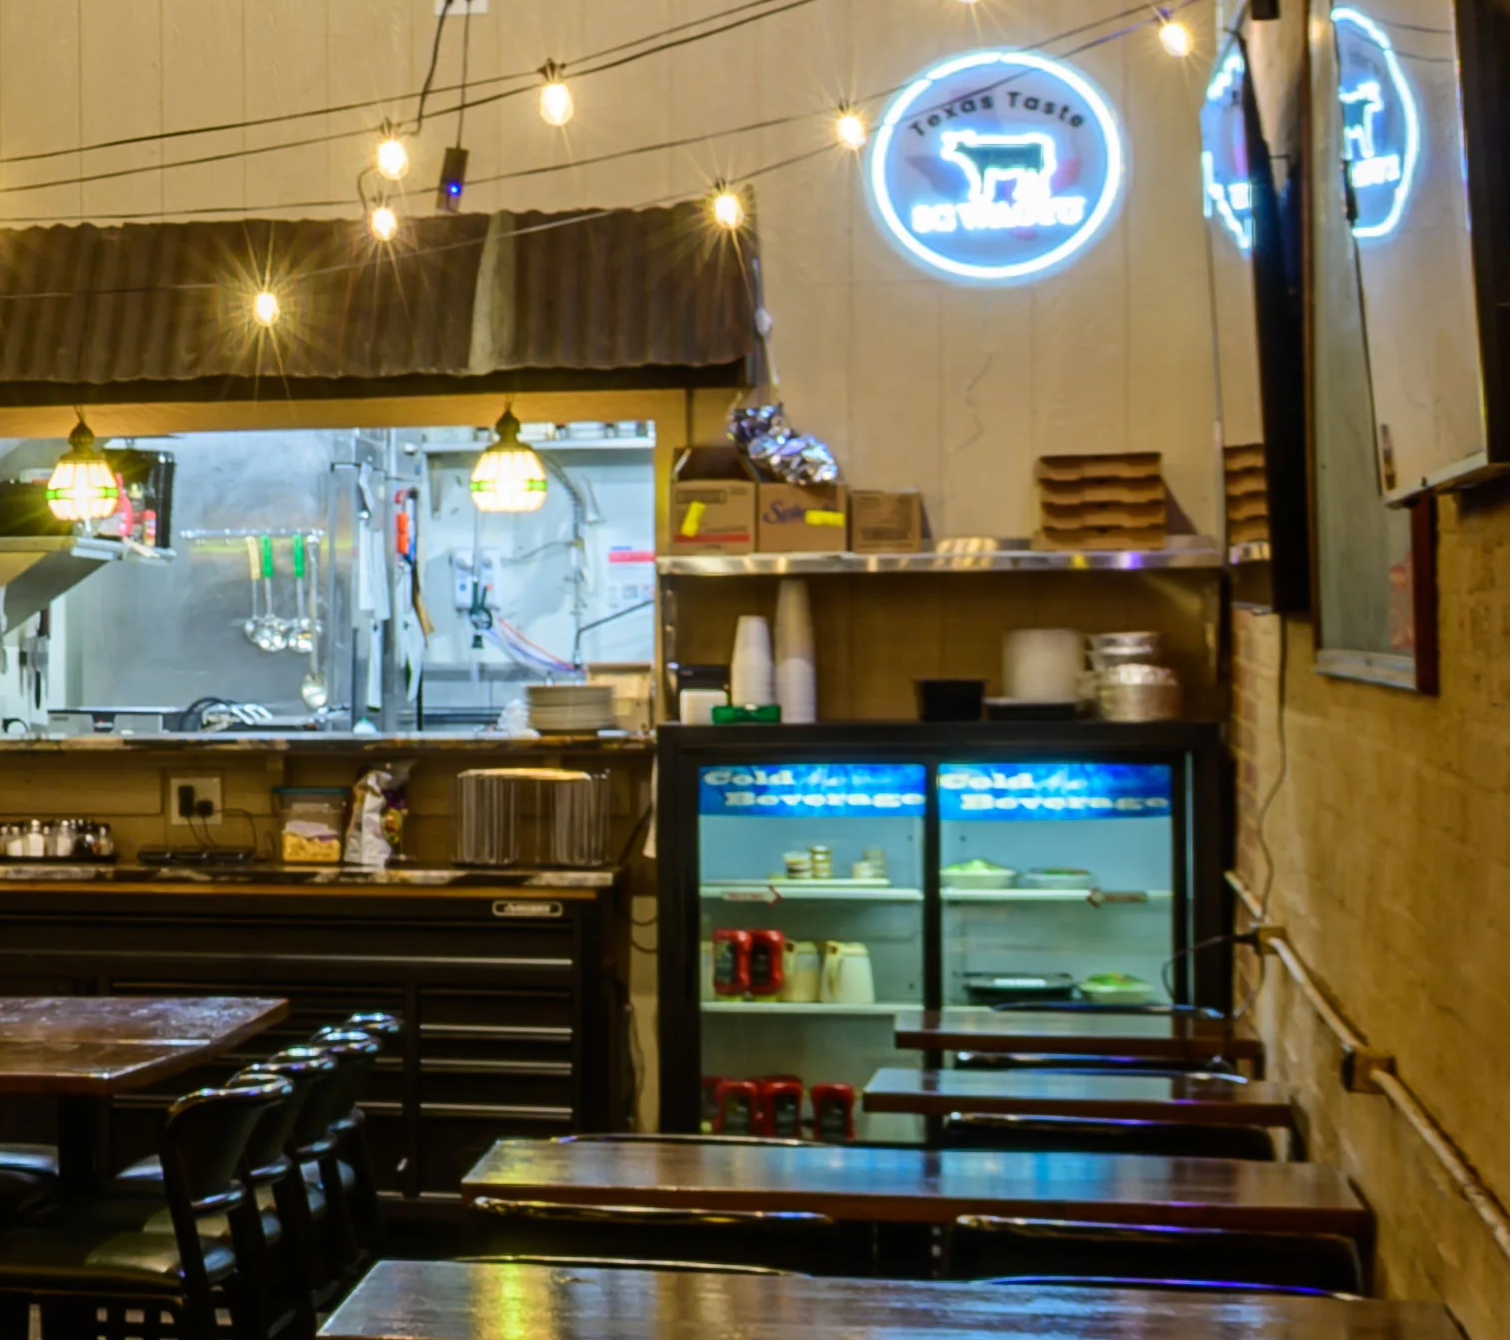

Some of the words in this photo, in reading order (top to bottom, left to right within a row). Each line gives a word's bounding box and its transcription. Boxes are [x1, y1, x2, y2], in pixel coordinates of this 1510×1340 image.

[909, 93, 994, 137] Texas
[1007, 90, 1086, 128] Taste
[702, 769, 795, 786] Cold
[938, 771, 1034, 790] Cold
[724, 791, 926, 808] Beverage
[959, 792, 1169, 812] Beverage
